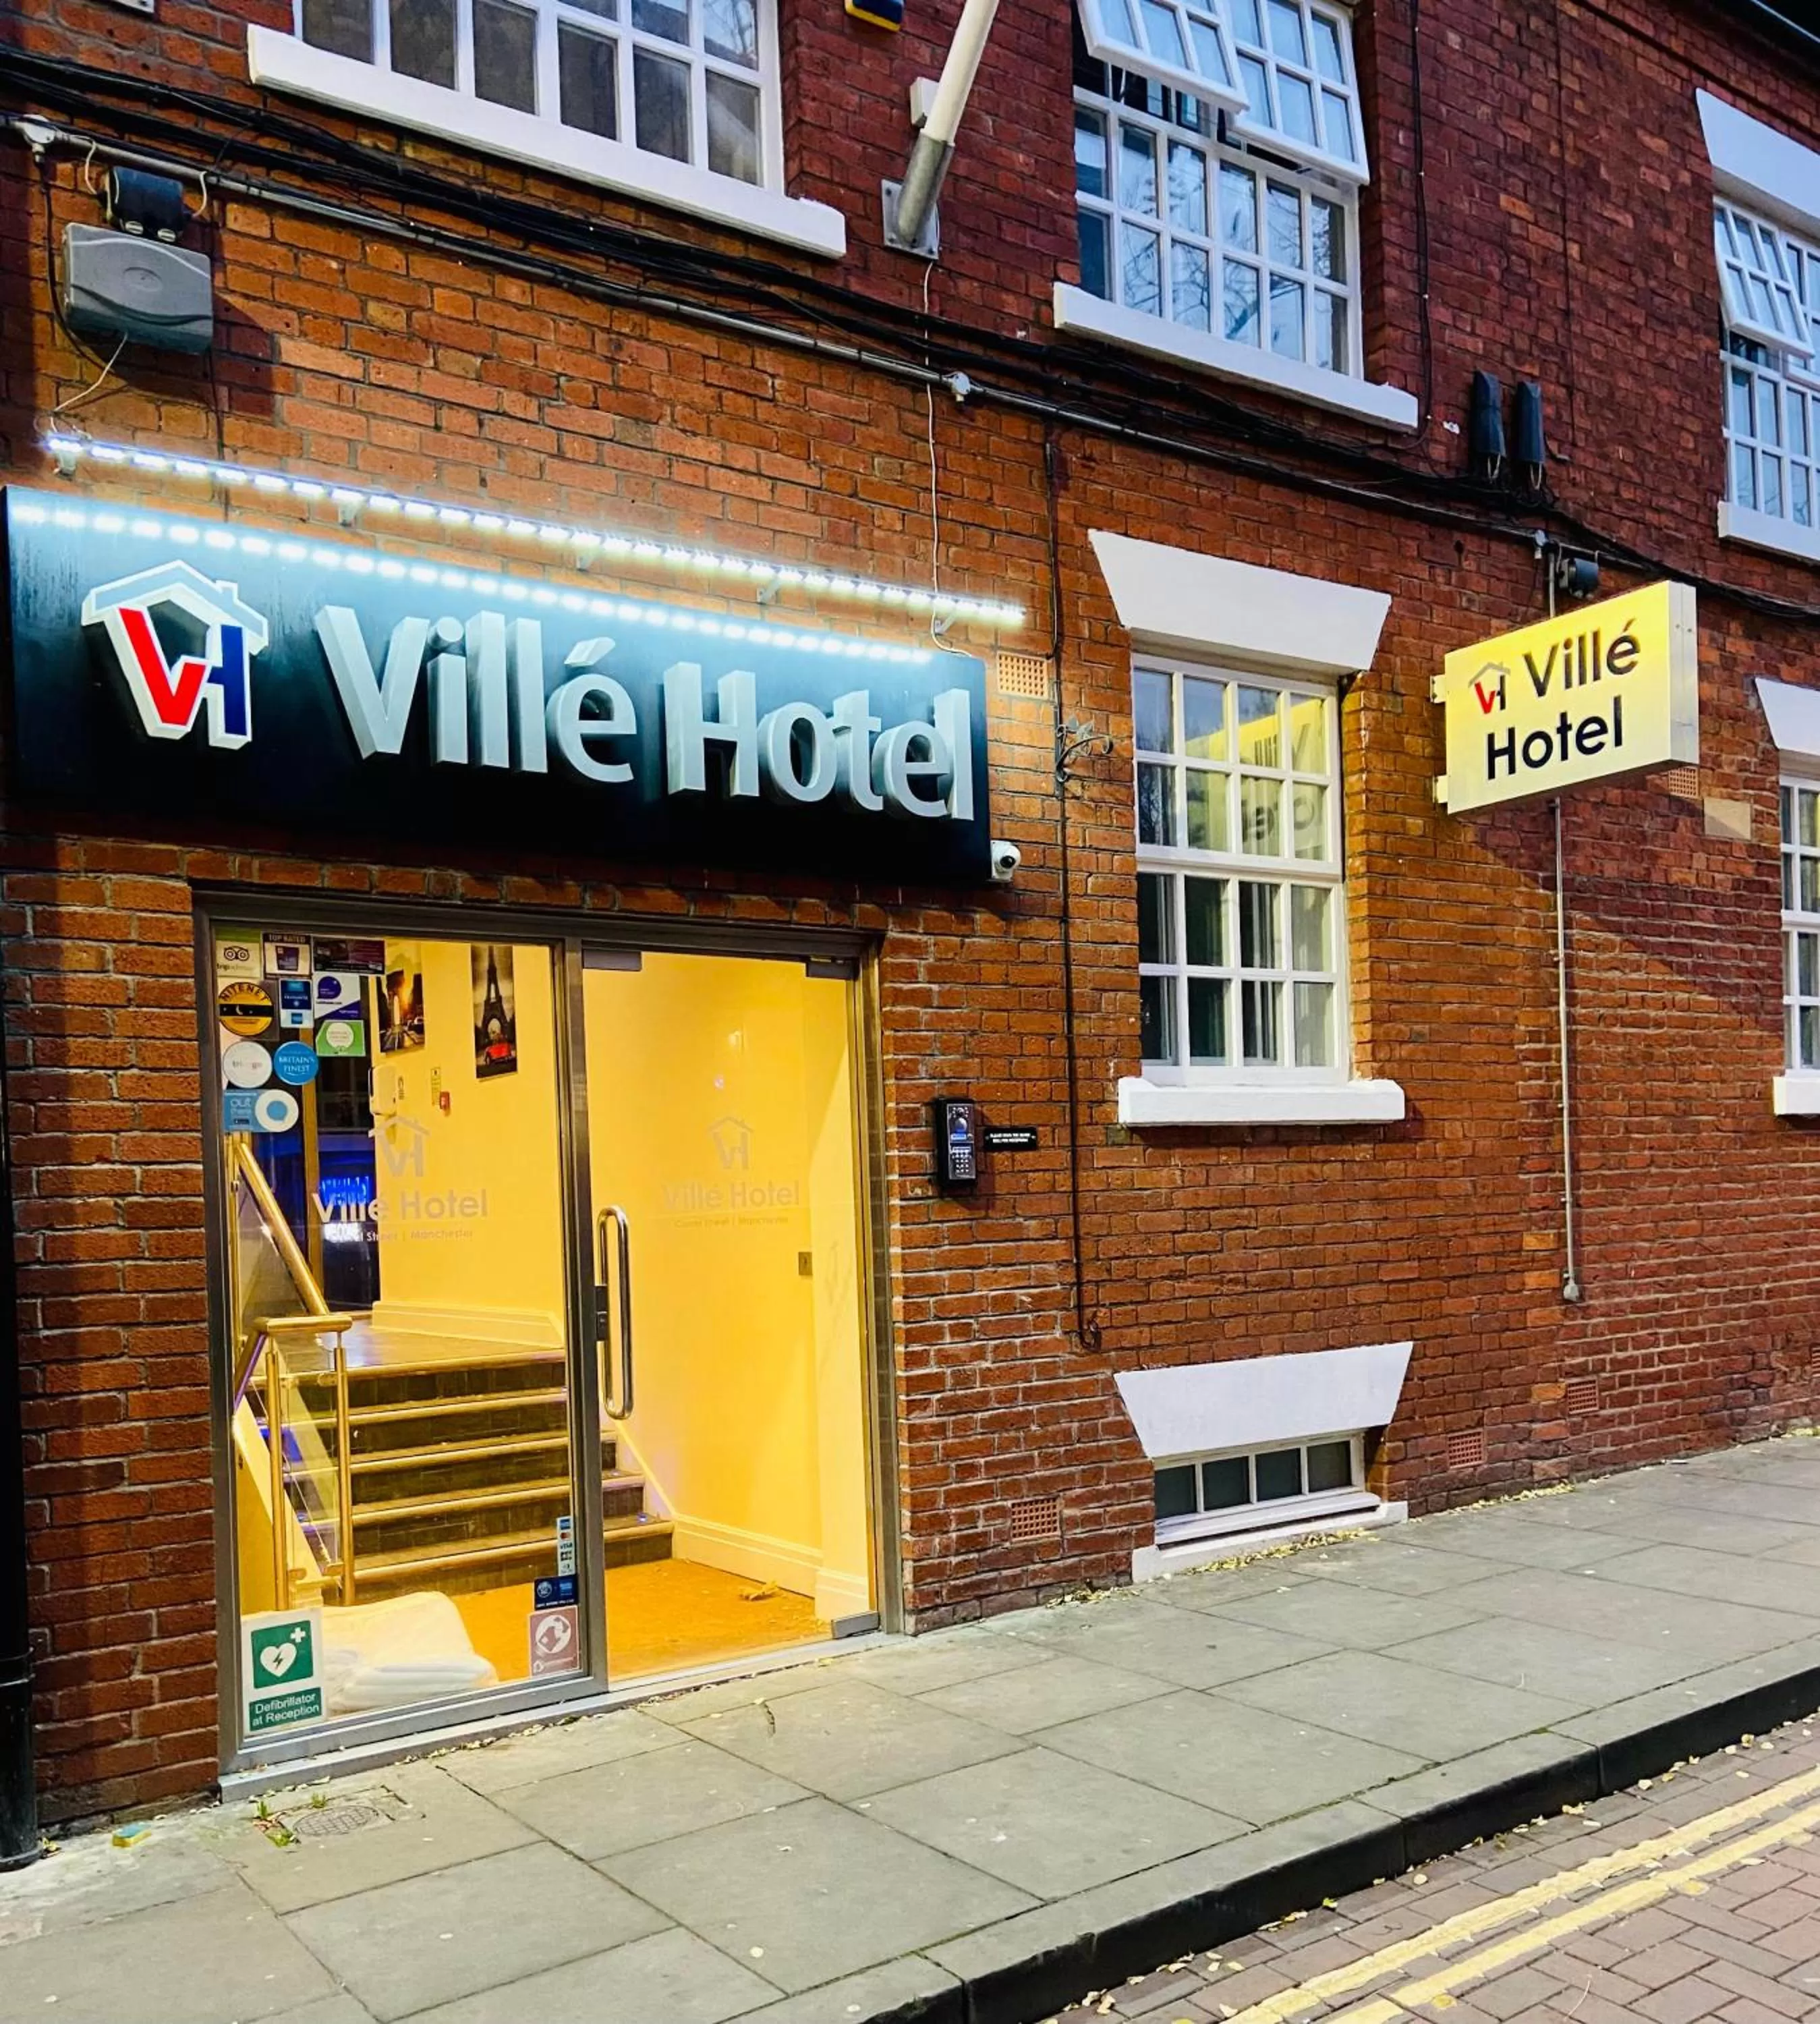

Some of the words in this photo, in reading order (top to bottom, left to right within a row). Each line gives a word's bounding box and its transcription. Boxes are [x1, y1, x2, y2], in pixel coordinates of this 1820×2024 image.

[1522, 618, 1641, 698] Villé
[315, 605, 637, 784] Villé
[664, 662, 973, 821] Hotel
[1487, 695, 1622, 781] Hotel
[269, 934, 281, 942] TOP
[279, 1056, 315, 1064] BRITAIN'S
[283, 1065, 310, 1073] FINEST
[401, 1189, 488, 1220] Hotel
[730, 1179, 799, 1210] Hotel
[252, 1716, 264, 1727] at
[266, 1705, 319, 1724] Reception
[255, 1693, 316, 1714] Defibrillator
